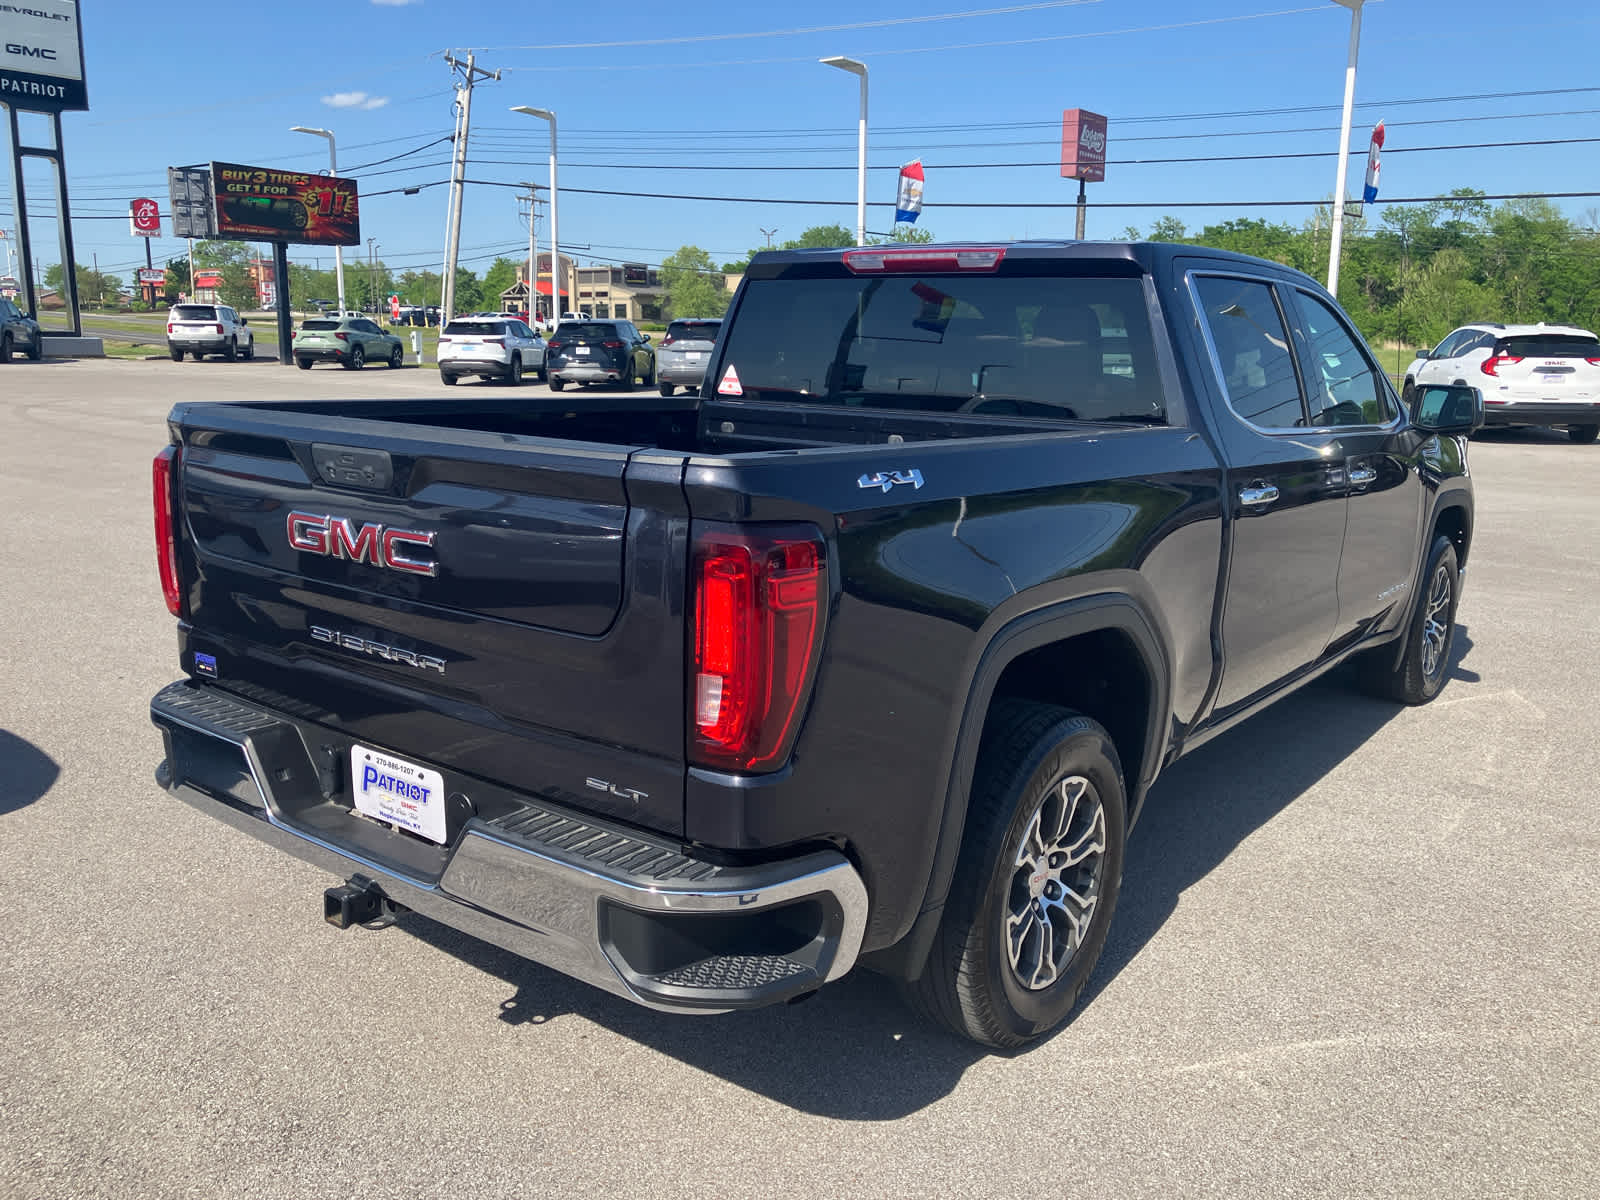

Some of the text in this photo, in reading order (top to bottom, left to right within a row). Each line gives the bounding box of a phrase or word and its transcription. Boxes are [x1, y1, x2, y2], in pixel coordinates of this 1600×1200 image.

[0, 5, 71, 21] EVROLET
[6, 43, 57, 60] GMC
[1, 78, 65, 98] PATRIOT
[222, 170, 309, 185] BUY 3 TIRES
[226, 183, 289, 195] GET 1 FOR
[286, 510, 438, 577] GMC
[310, 625, 447, 674] SIERRA
[363, 765, 431, 804] PATRIOT
[585, 776, 649, 804] SLT
